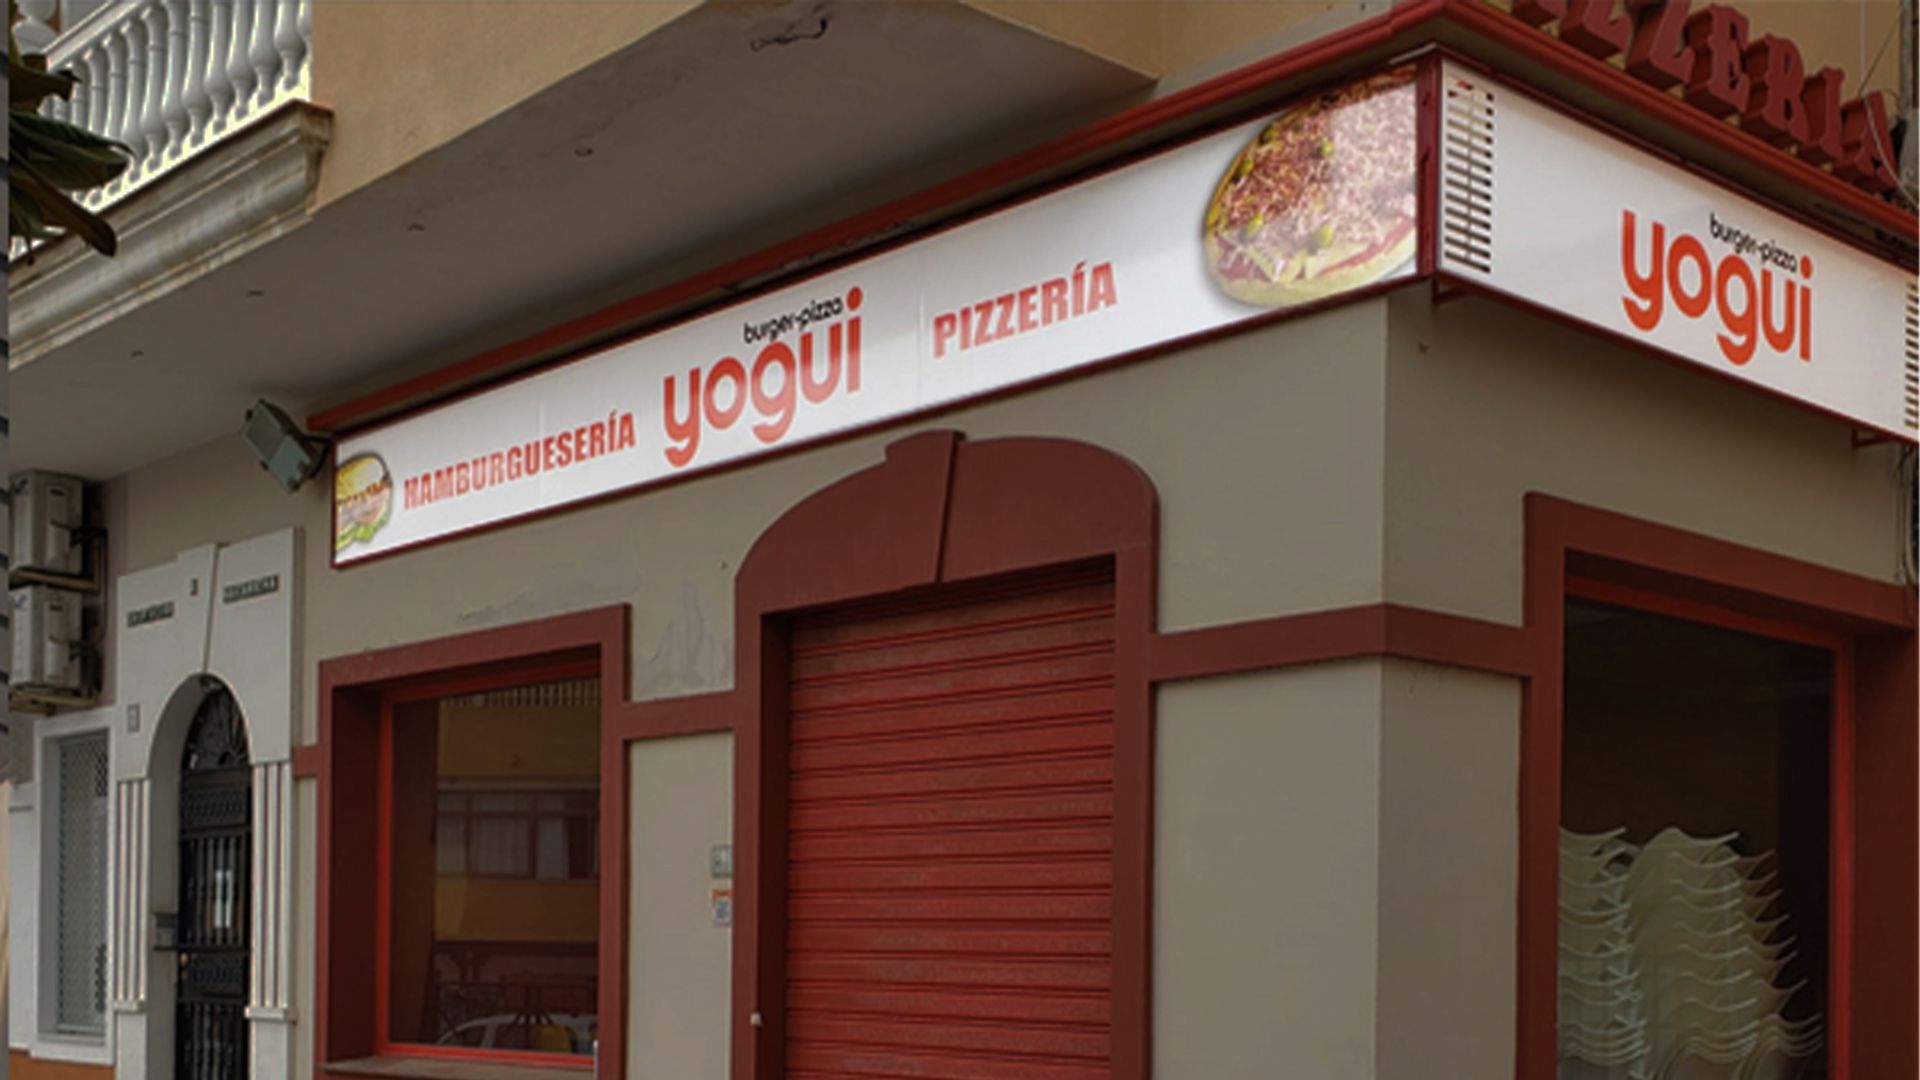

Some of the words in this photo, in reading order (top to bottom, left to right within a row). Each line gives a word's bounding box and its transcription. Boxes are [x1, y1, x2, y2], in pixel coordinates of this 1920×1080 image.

[1621, 209, 1813, 365] yogui
[1709, 212, 1798, 273] burger-pizza
[743, 297, 844, 344] burger-pizza
[403, 409, 636, 510] HAMBURGUESERÍA
[663, 286, 864, 467] yogui
[933, 260, 1118, 359] PIZZERÍA
